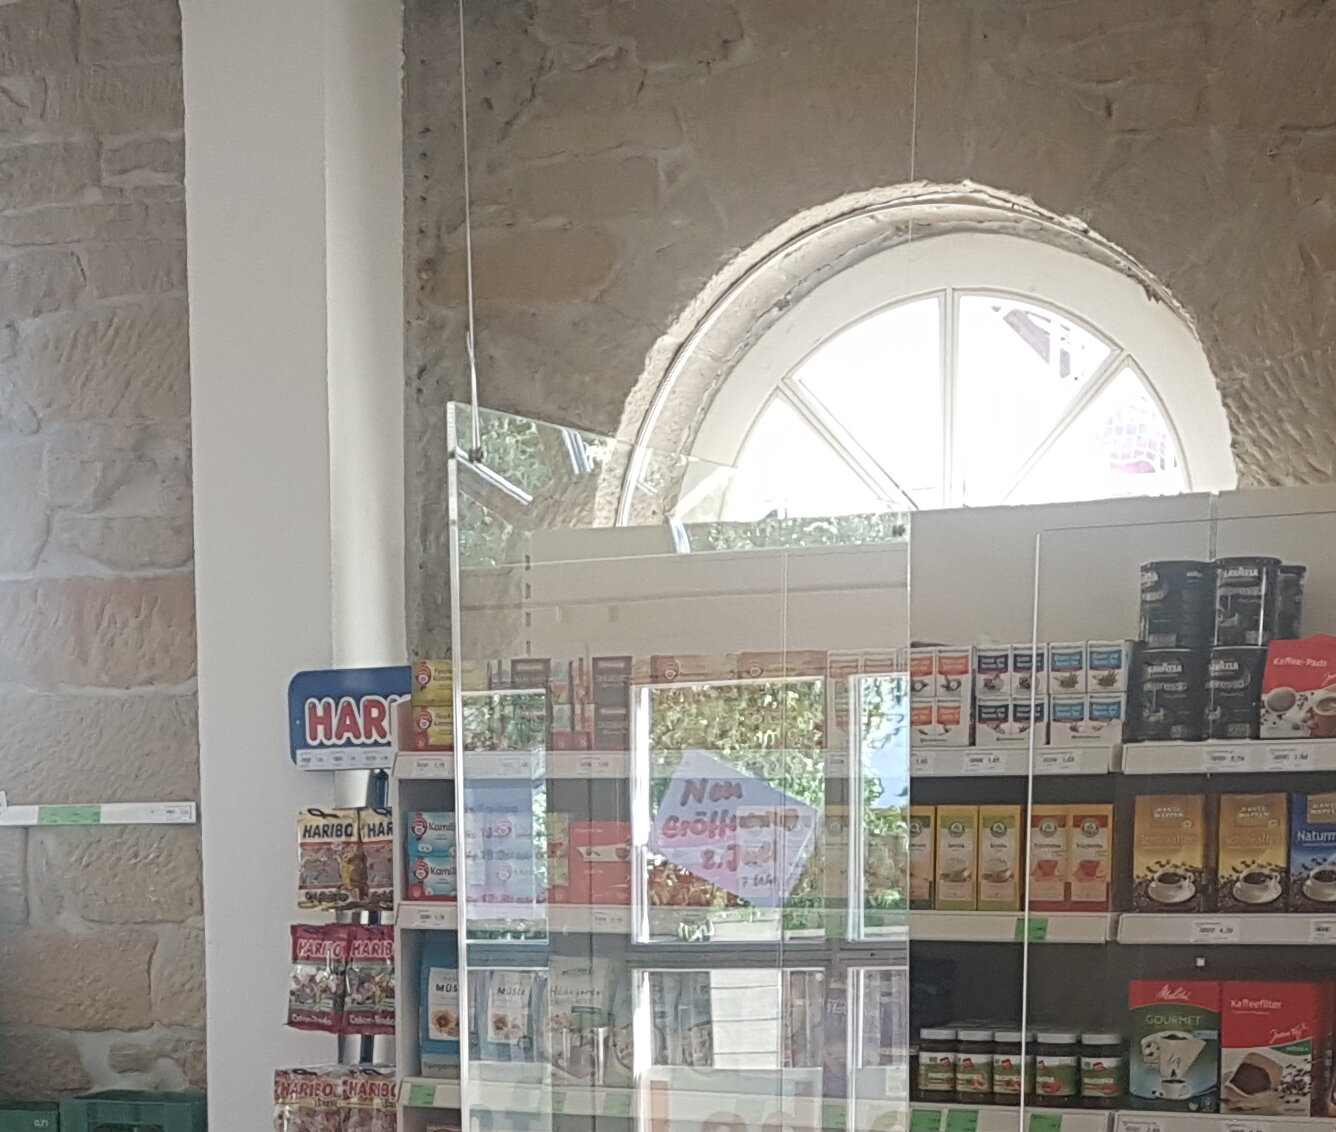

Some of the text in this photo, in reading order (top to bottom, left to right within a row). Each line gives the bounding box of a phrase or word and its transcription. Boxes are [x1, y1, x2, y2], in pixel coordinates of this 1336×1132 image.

[302, 823, 354, 839] HARIBO
[298, 939, 342, 957] HARIBO
[1230, 1000, 1282, 1010] Kaffeefilter
[1146, 1015, 1201, 1026] GOURMET
[279, 1079, 338, 1096] HARIBO
